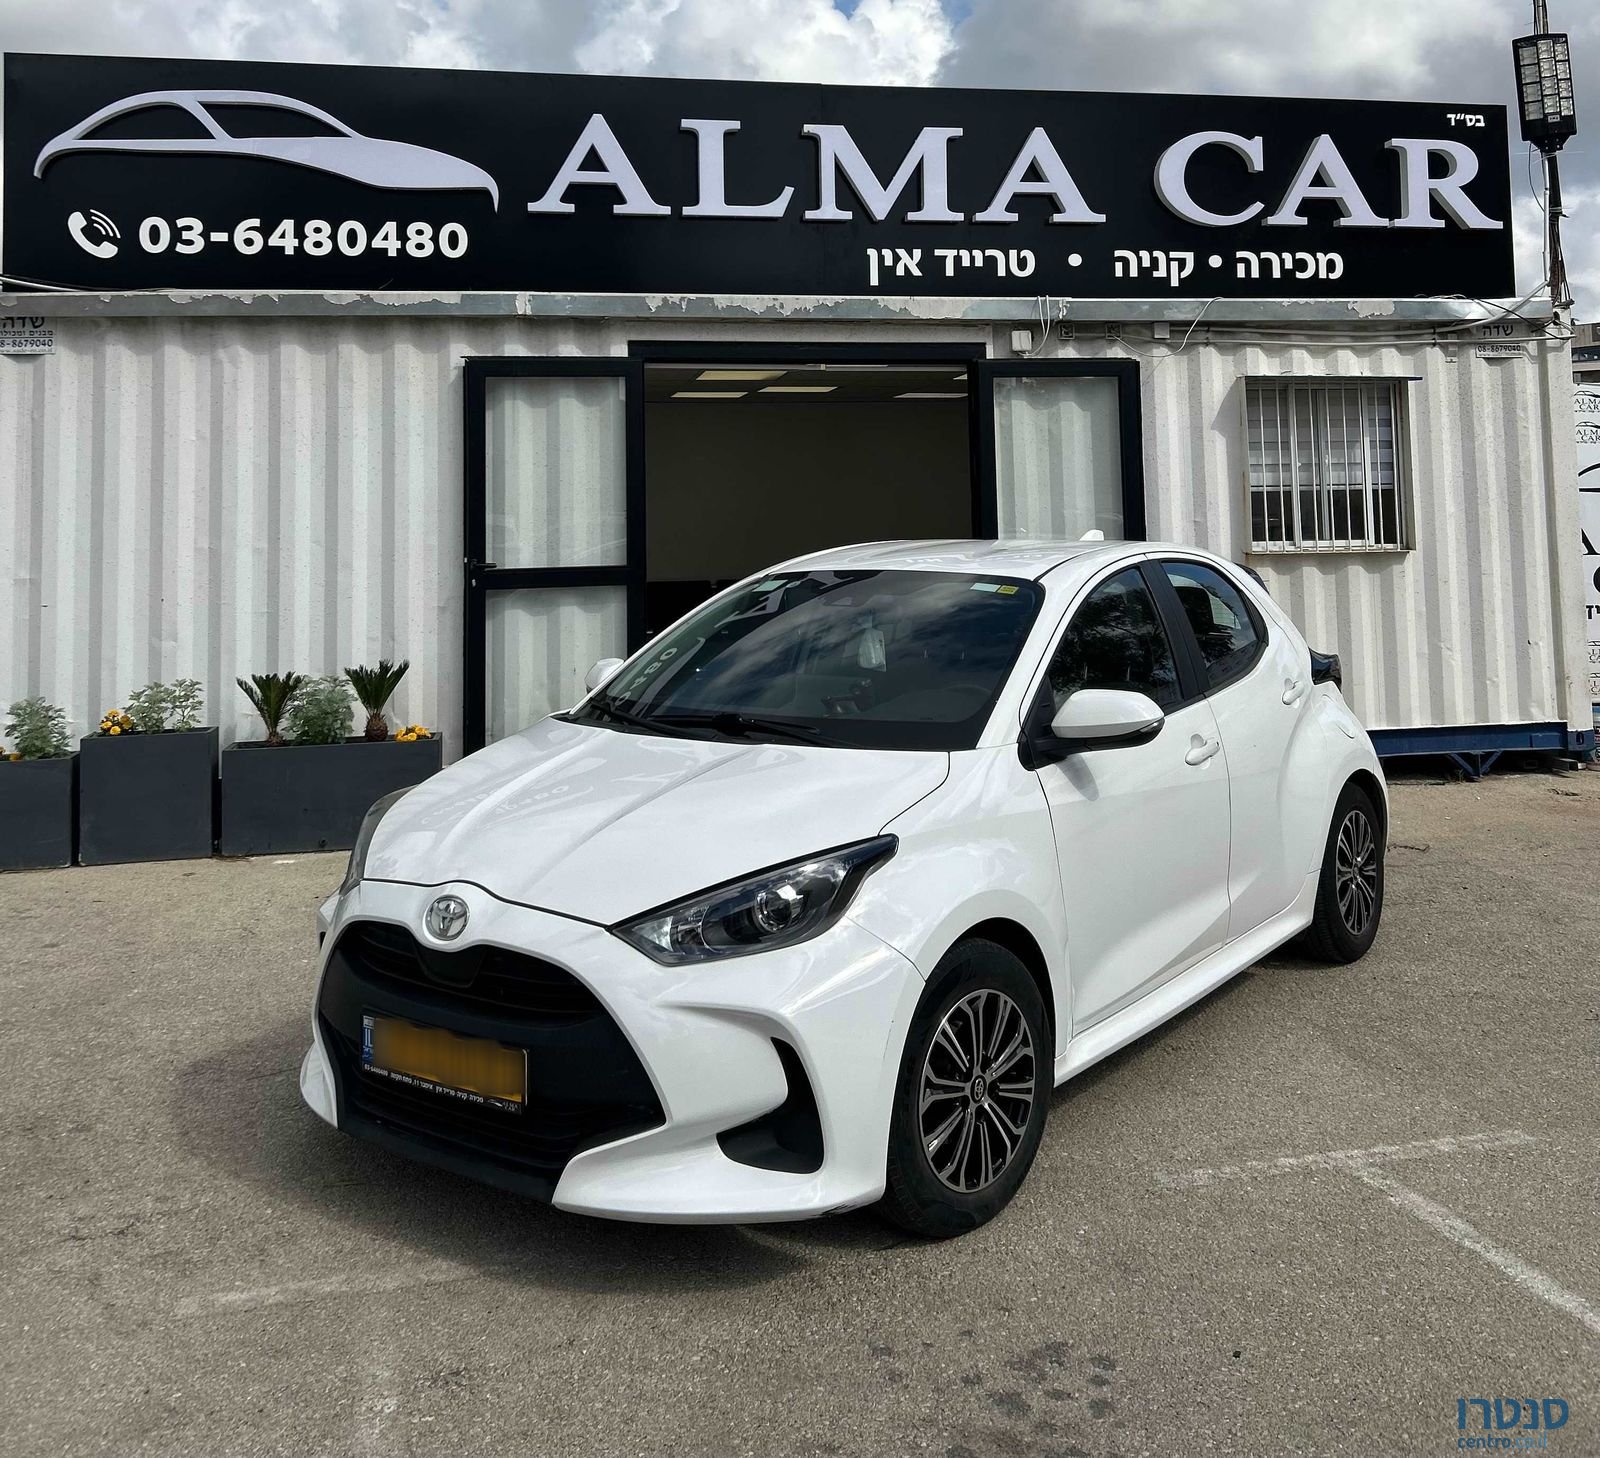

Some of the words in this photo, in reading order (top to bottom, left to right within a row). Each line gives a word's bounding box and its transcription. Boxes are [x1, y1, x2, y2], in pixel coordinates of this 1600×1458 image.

[527, 113, 1107, 224] ALMA
[1154, 131, 1504, 230] CAR
[138, 216, 469, 259] 03-6480480
[866, 248, 923, 286] אין
[934, 249, 1036, 278] טרייד
[1113, 250, 1195, 287] קניה
[1235, 250, 1344, 280] מכירה
[0, 339, 53, 347] 8-8679040
[1482, 325, 1514, 336] שדה
